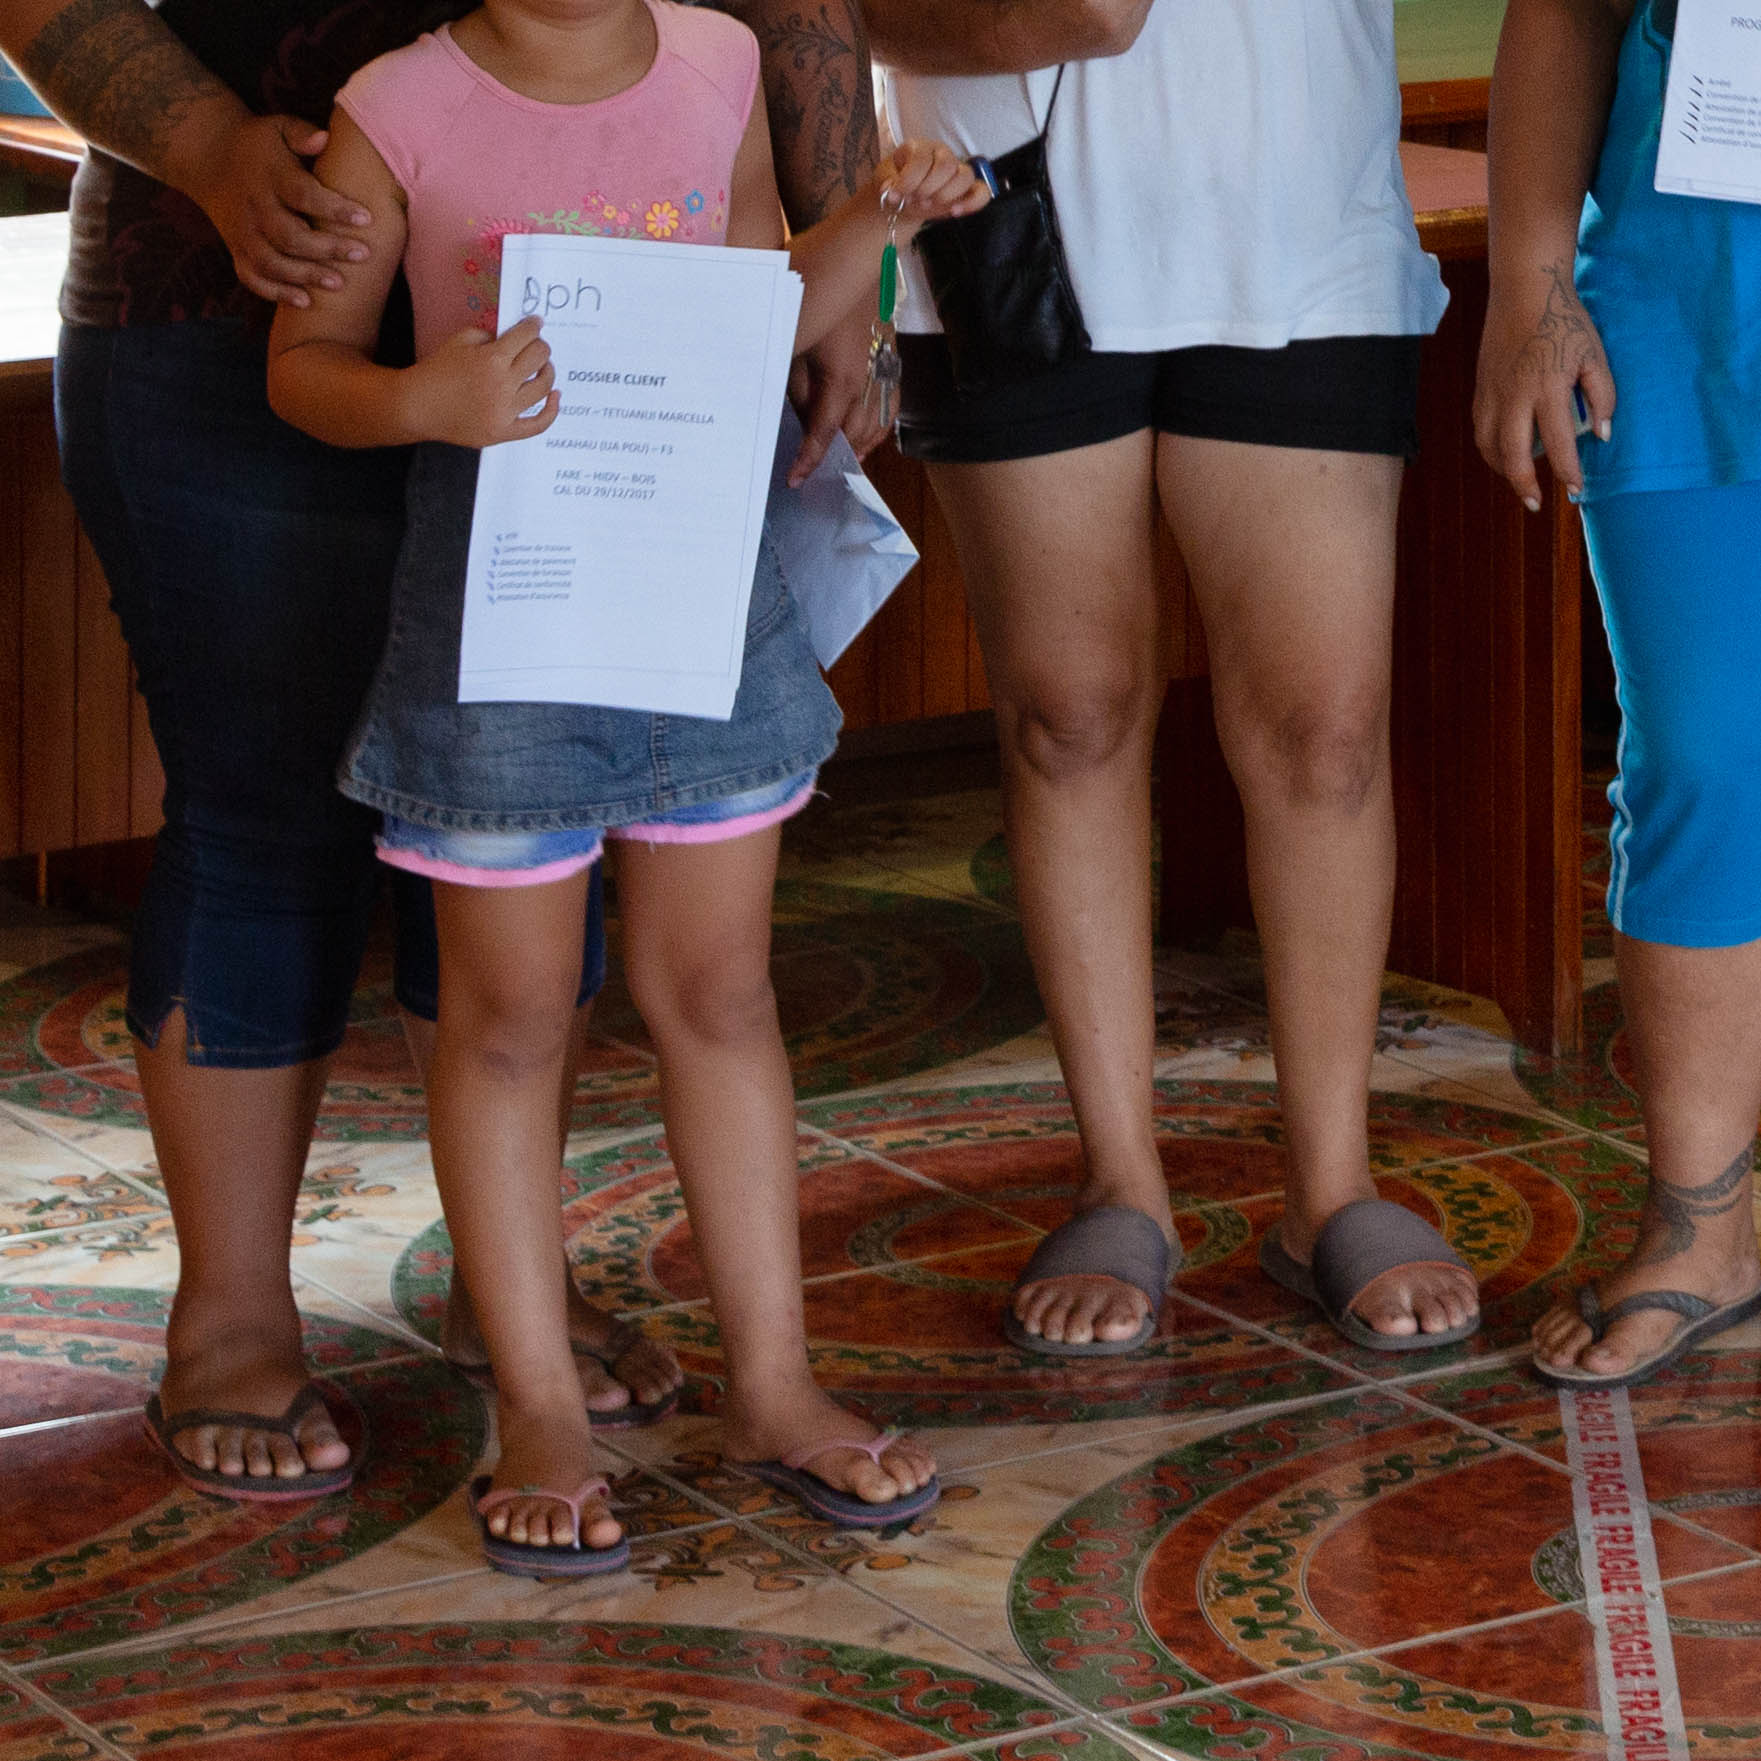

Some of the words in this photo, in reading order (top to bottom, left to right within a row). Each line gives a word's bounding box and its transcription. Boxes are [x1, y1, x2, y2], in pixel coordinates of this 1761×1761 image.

[567, 370, 620, 385] DOSSIER
[624, 374, 667, 388] CLIENT
[1574, 1390, 1619, 1443] RAGILE
[1582, 1452, 1632, 1516] FRAGILE
[1594, 1525, 1644, 1593] FRAGILE
[1604, 1605, 1657, 1678] FRAGILE
[1617, 1690, 1670, 1761] FRAGIL
